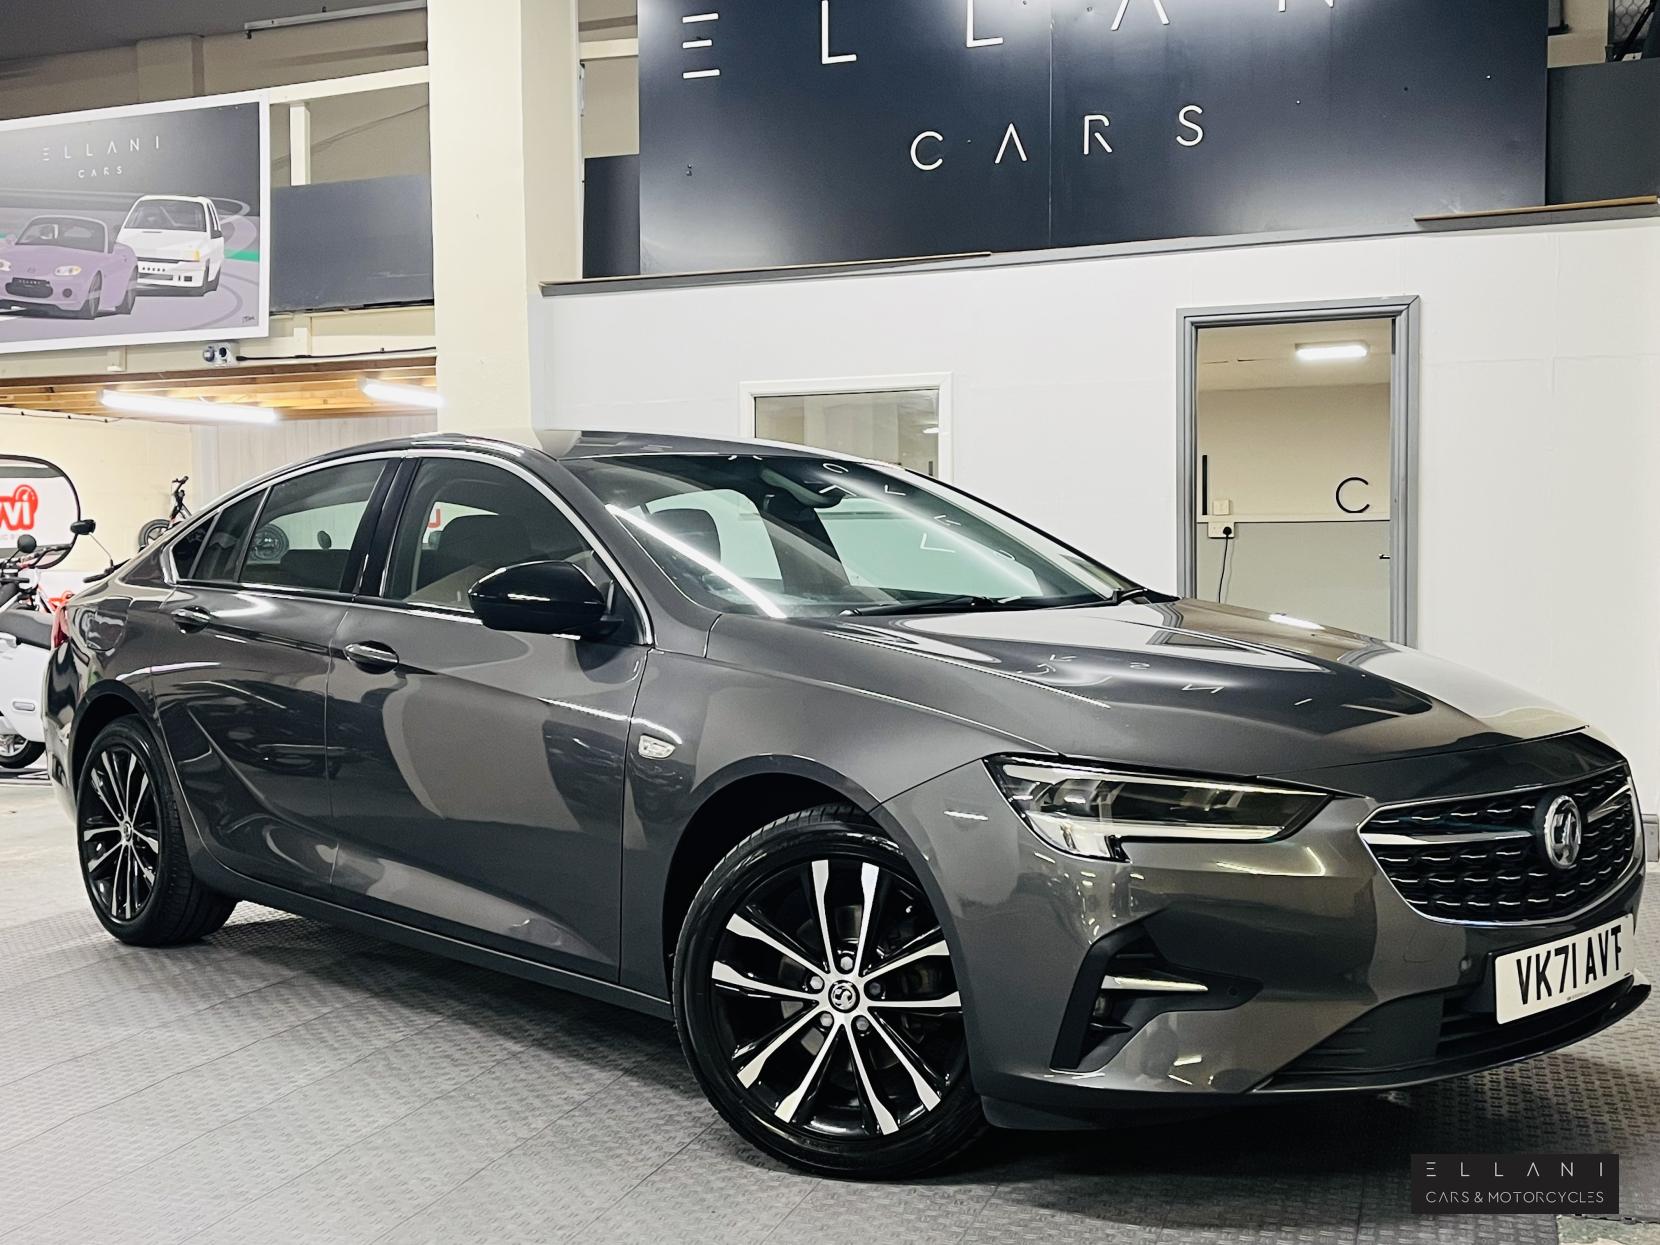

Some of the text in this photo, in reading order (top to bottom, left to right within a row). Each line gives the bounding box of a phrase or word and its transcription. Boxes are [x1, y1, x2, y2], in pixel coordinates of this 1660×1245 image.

[42, 135, 160, 161] ELLANI
[908, 104, 1204, 171] CARS
[78, 166, 123, 179] CARS
[1515, 924, 1622, 1005] VK71 AVT
